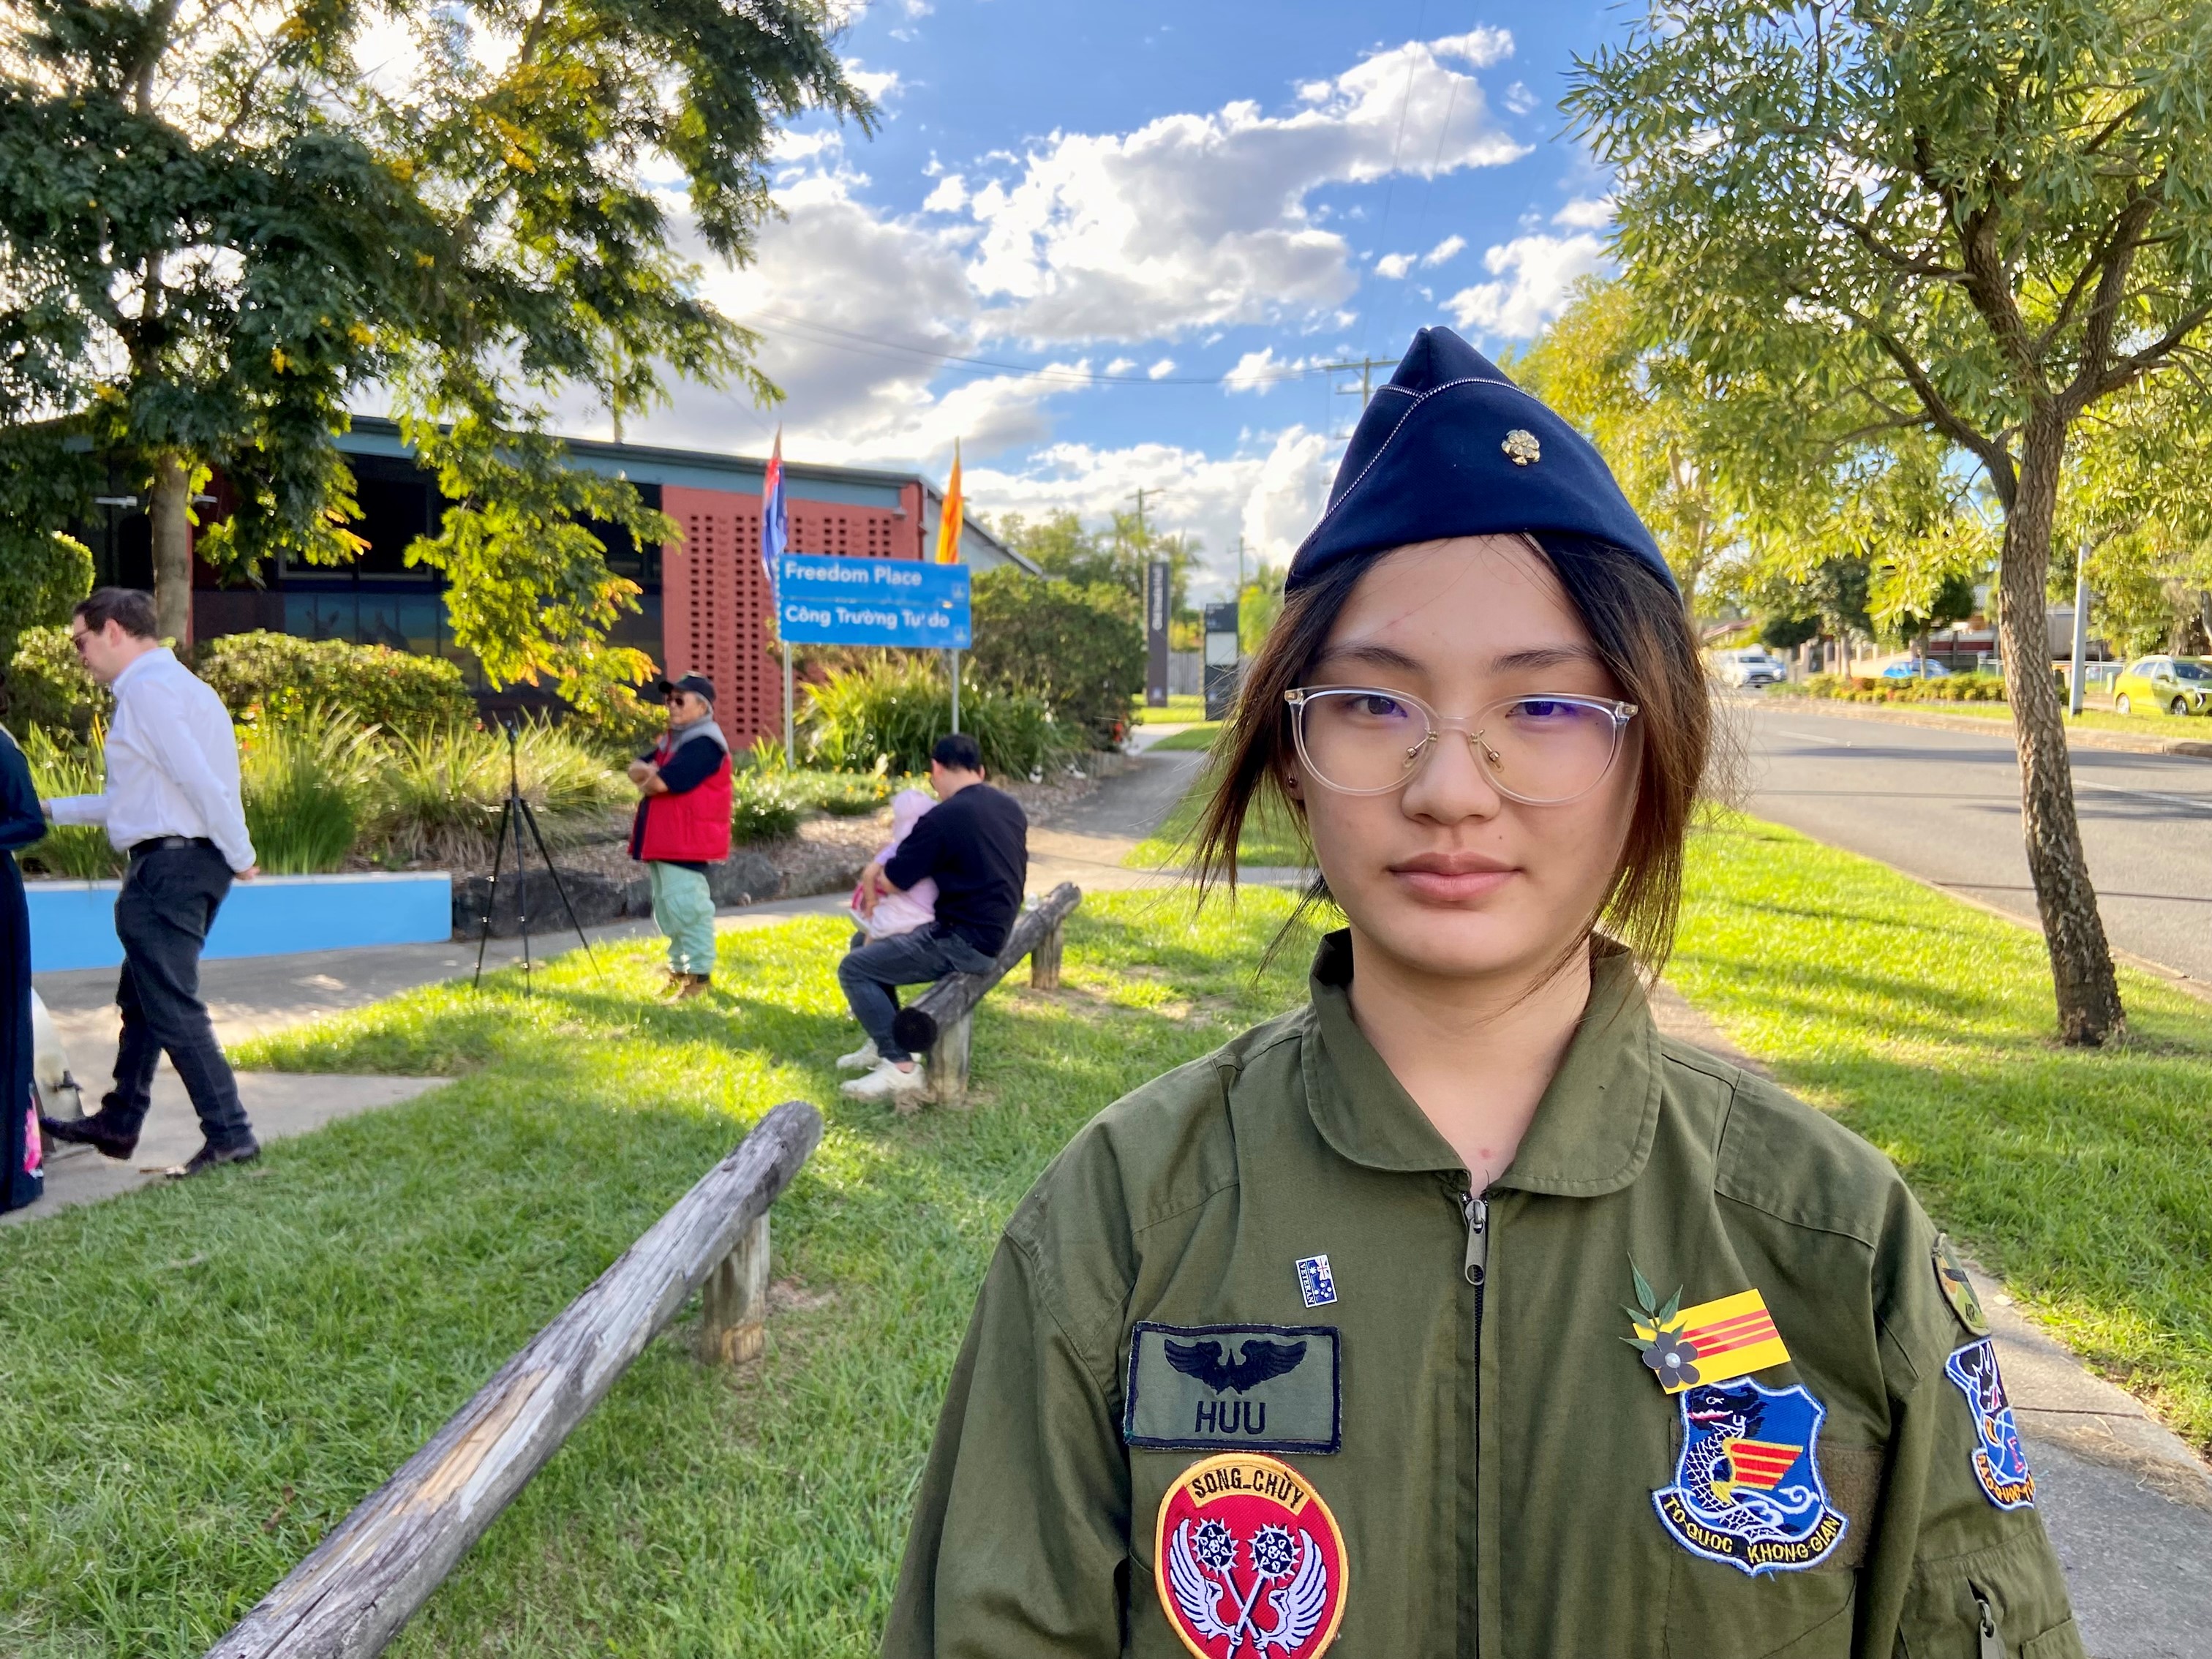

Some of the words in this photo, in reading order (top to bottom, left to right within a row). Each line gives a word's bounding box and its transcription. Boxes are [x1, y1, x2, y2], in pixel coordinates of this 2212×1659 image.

[784, 561, 869, 584] Freedom
[873, 565, 922, 586] Place
[785, 605, 831, 627] Công
[928, 611, 950, 628] do
[1299, 1263, 1314, 1304] VETERAN
[1195, 1400, 1266, 1435] HUU
